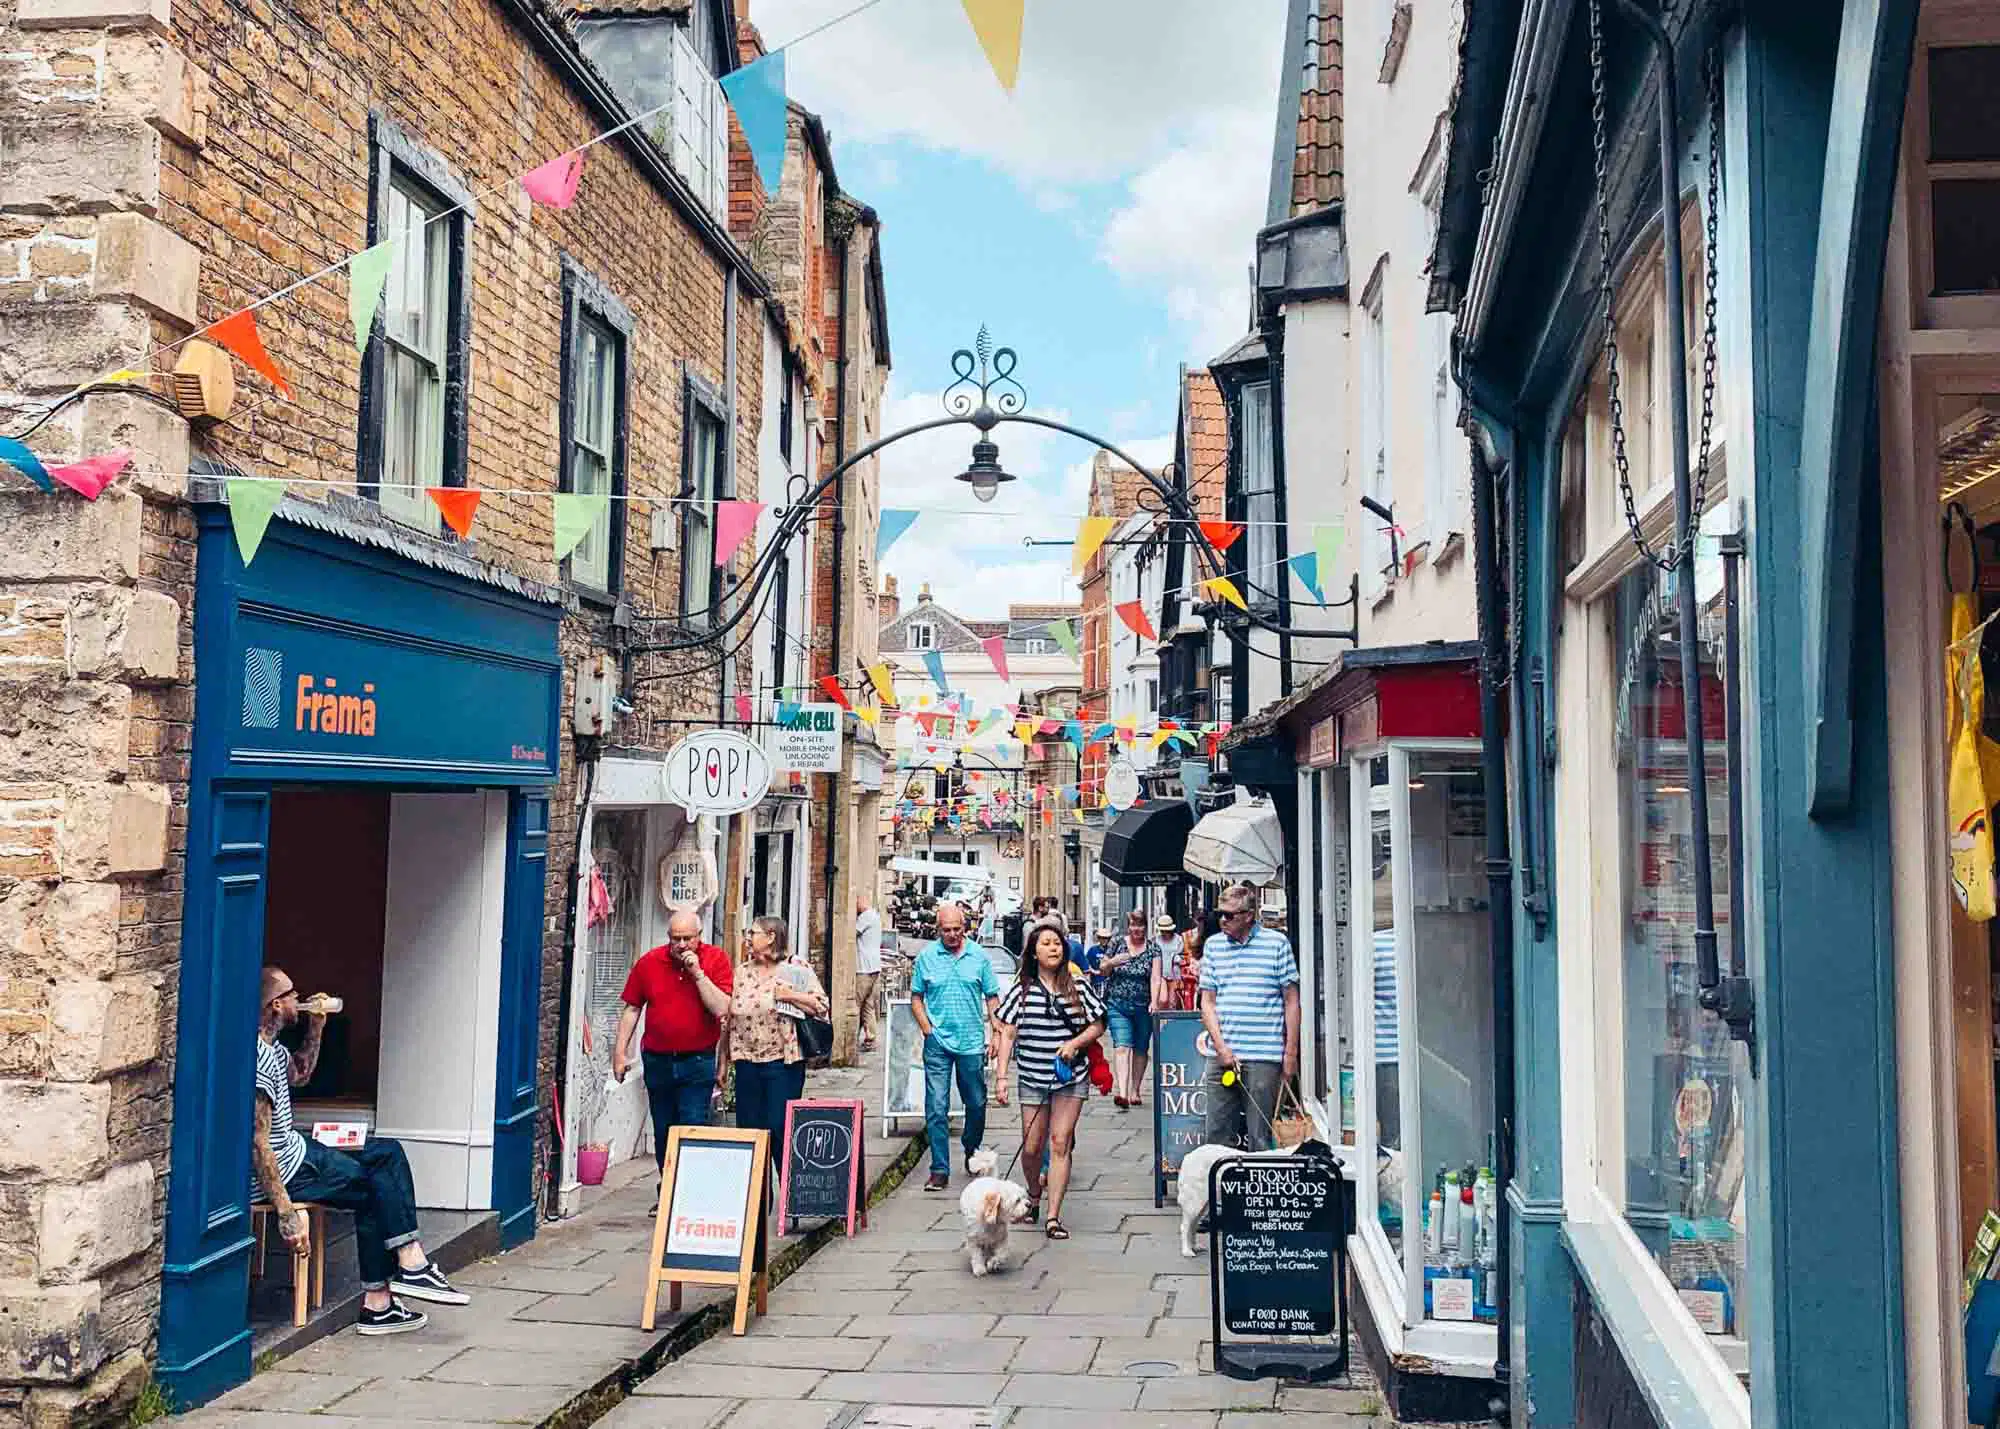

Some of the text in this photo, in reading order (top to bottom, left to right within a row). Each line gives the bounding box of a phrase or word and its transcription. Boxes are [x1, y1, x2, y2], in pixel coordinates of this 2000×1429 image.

[814, 712, 835, 731] CELL
[688, 747, 750, 798] POP!
[672, 864, 698, 874] JUST
[672, 876, 686, 887] BE
[672, 889, 697, 900] NICE
[805, 1128, 836, 1159] POP!
[1249, 1169, 1299, 1182] FROME
[1222, 1181, 1326, 1195] WHOLEFOODS
[1246, 1197, 1273, 1207] OPEN
[1267, 1210, 1290, 1218] BREAD
[1252, 1222, 1304, 1231] HOBBS HOUSE
[1226, 1234, 1275, 1250] Organic Veg
[1225, 1248, 1256, 1262] Organic
[1249, 1308, 1310, 1320] FOOD BANK
[1232, 1321, 1276, 1329] DONATIONS
[1291, 1321, 1316, 1331] STORE
